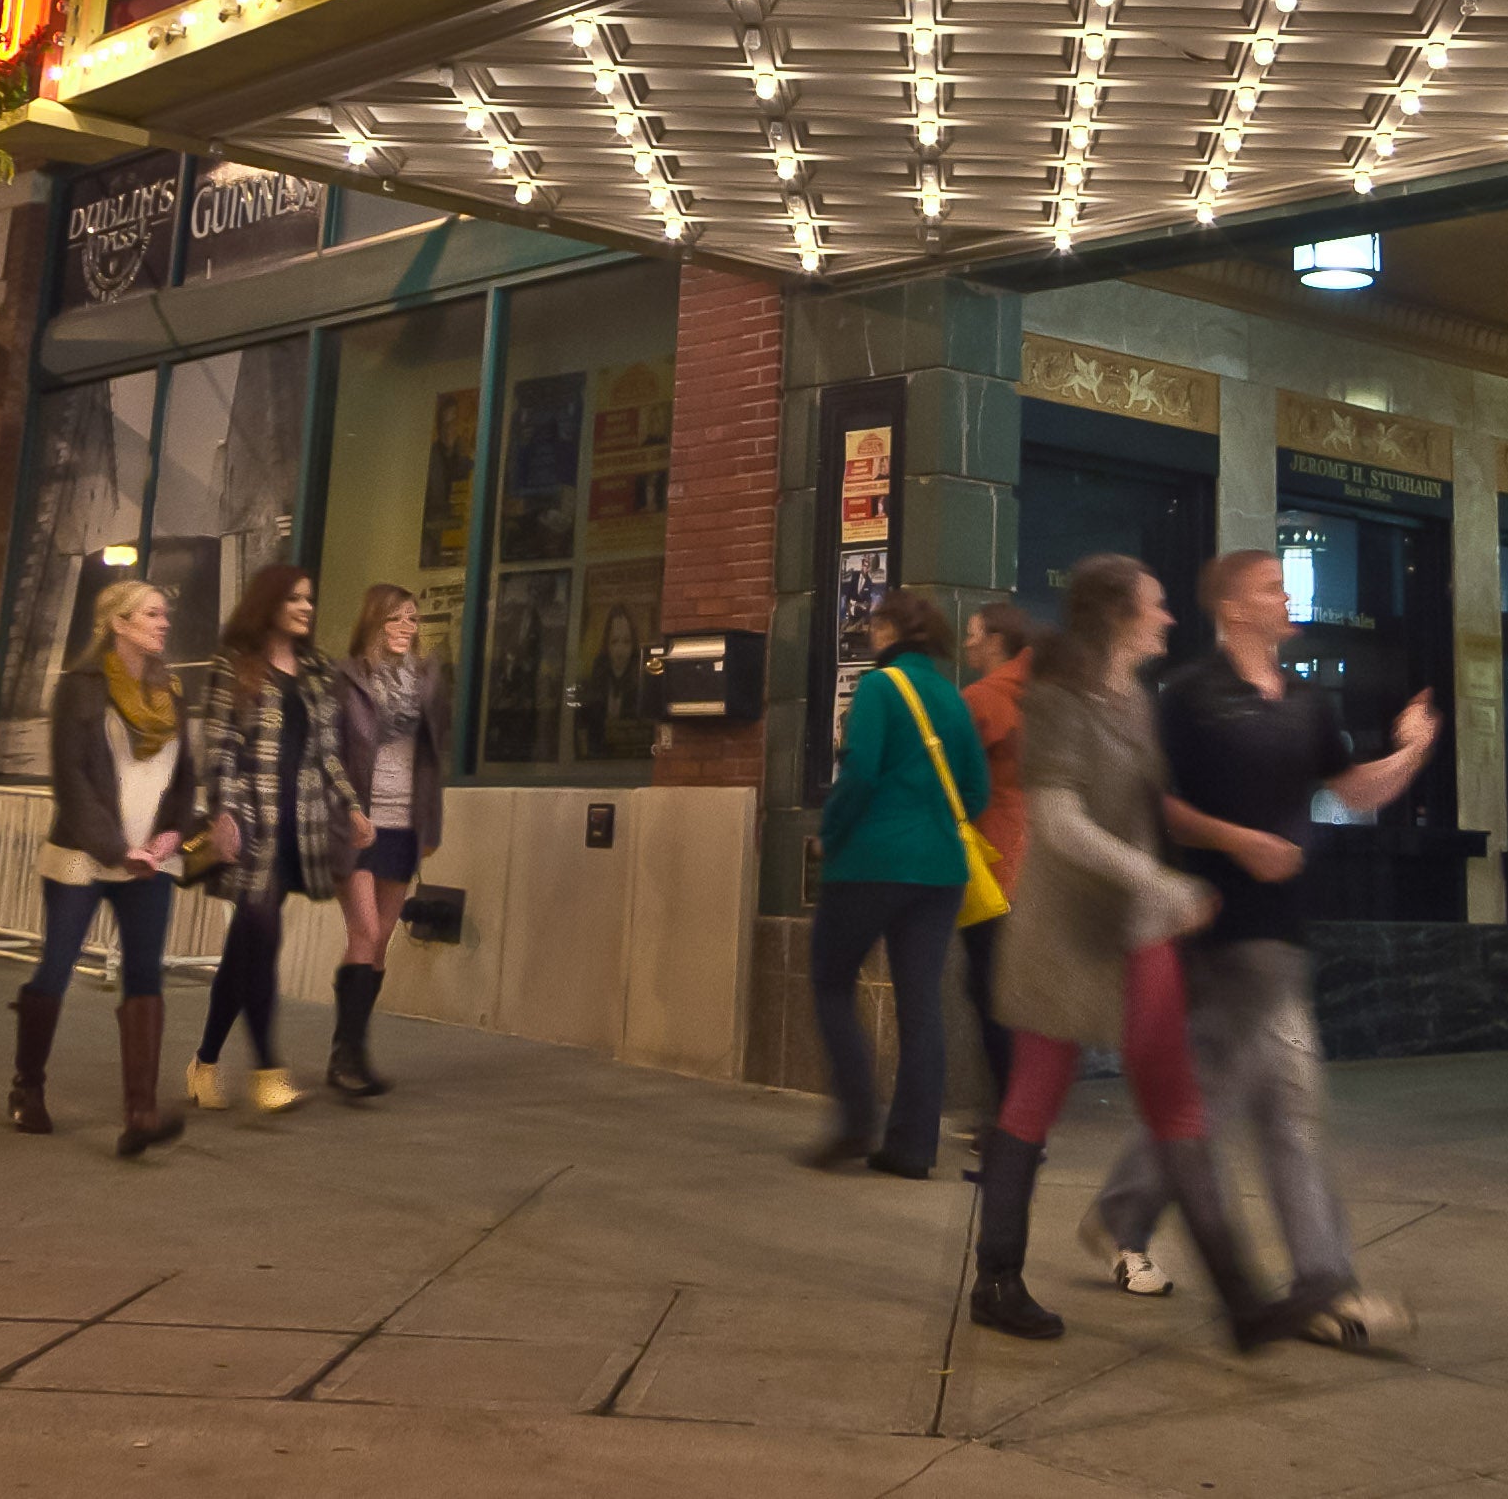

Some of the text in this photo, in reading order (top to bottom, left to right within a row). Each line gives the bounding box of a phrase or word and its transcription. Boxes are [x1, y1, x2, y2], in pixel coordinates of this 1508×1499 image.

[68, 177, 175, 239] DUBLIN'S
[1290, 453, 1348, 480] JEROME
[1370, 469, 1442, 498] STURHAHN
